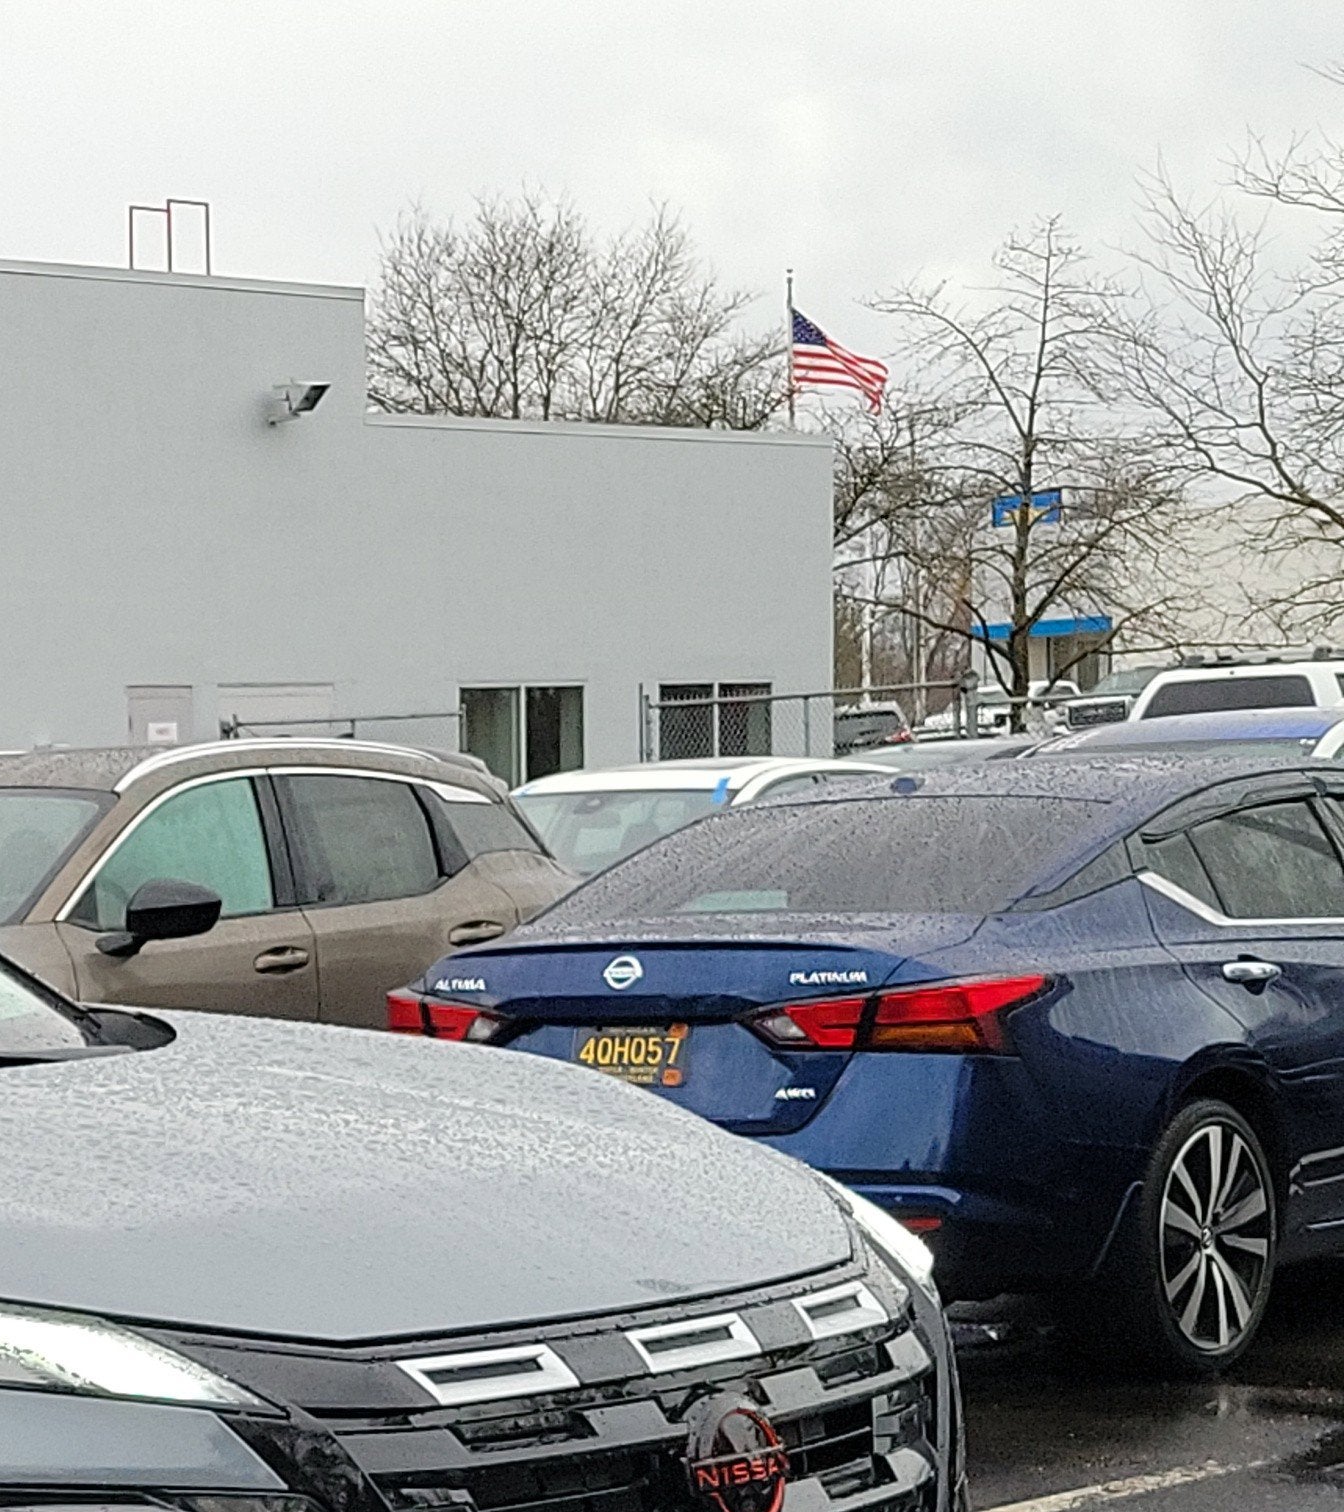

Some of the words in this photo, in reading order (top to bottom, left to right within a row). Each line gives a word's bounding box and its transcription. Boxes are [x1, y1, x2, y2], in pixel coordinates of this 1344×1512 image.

[434, 977, 487, 992] ALTIMA
[789, 971, 868, 985] PLATINUM
[774, 1086, 817, 1101] AWD
[696, 1456, 782, 1489] NISSA
